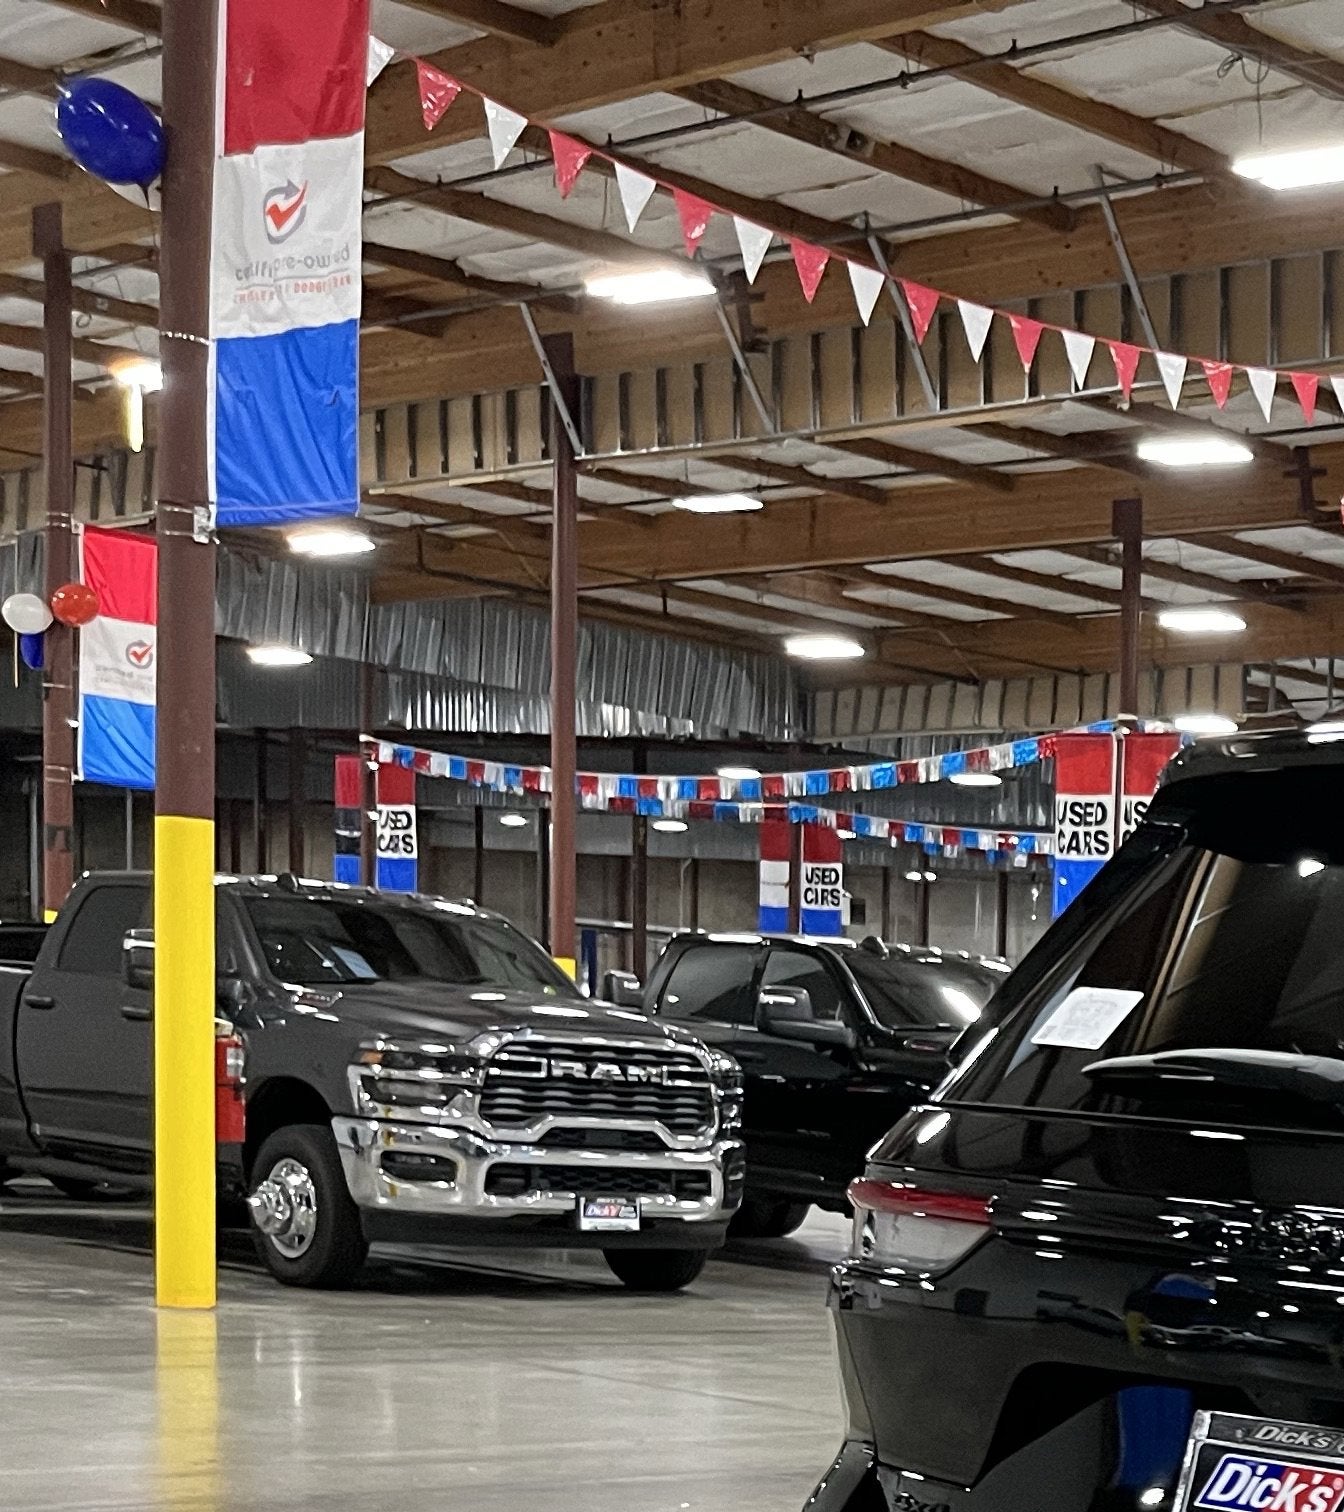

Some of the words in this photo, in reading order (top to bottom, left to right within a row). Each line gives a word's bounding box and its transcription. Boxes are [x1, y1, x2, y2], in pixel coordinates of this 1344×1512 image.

[273, 242, 350, 272] pre-owed
[1057, 801, 1108, 827] USED
[1057, 829, 1110, 856] CARS
[805, 866, 840, 886] USED
[550, 1060, 663, 1082] RAM
[1254, 1425, 1333, 1449] Dick's
